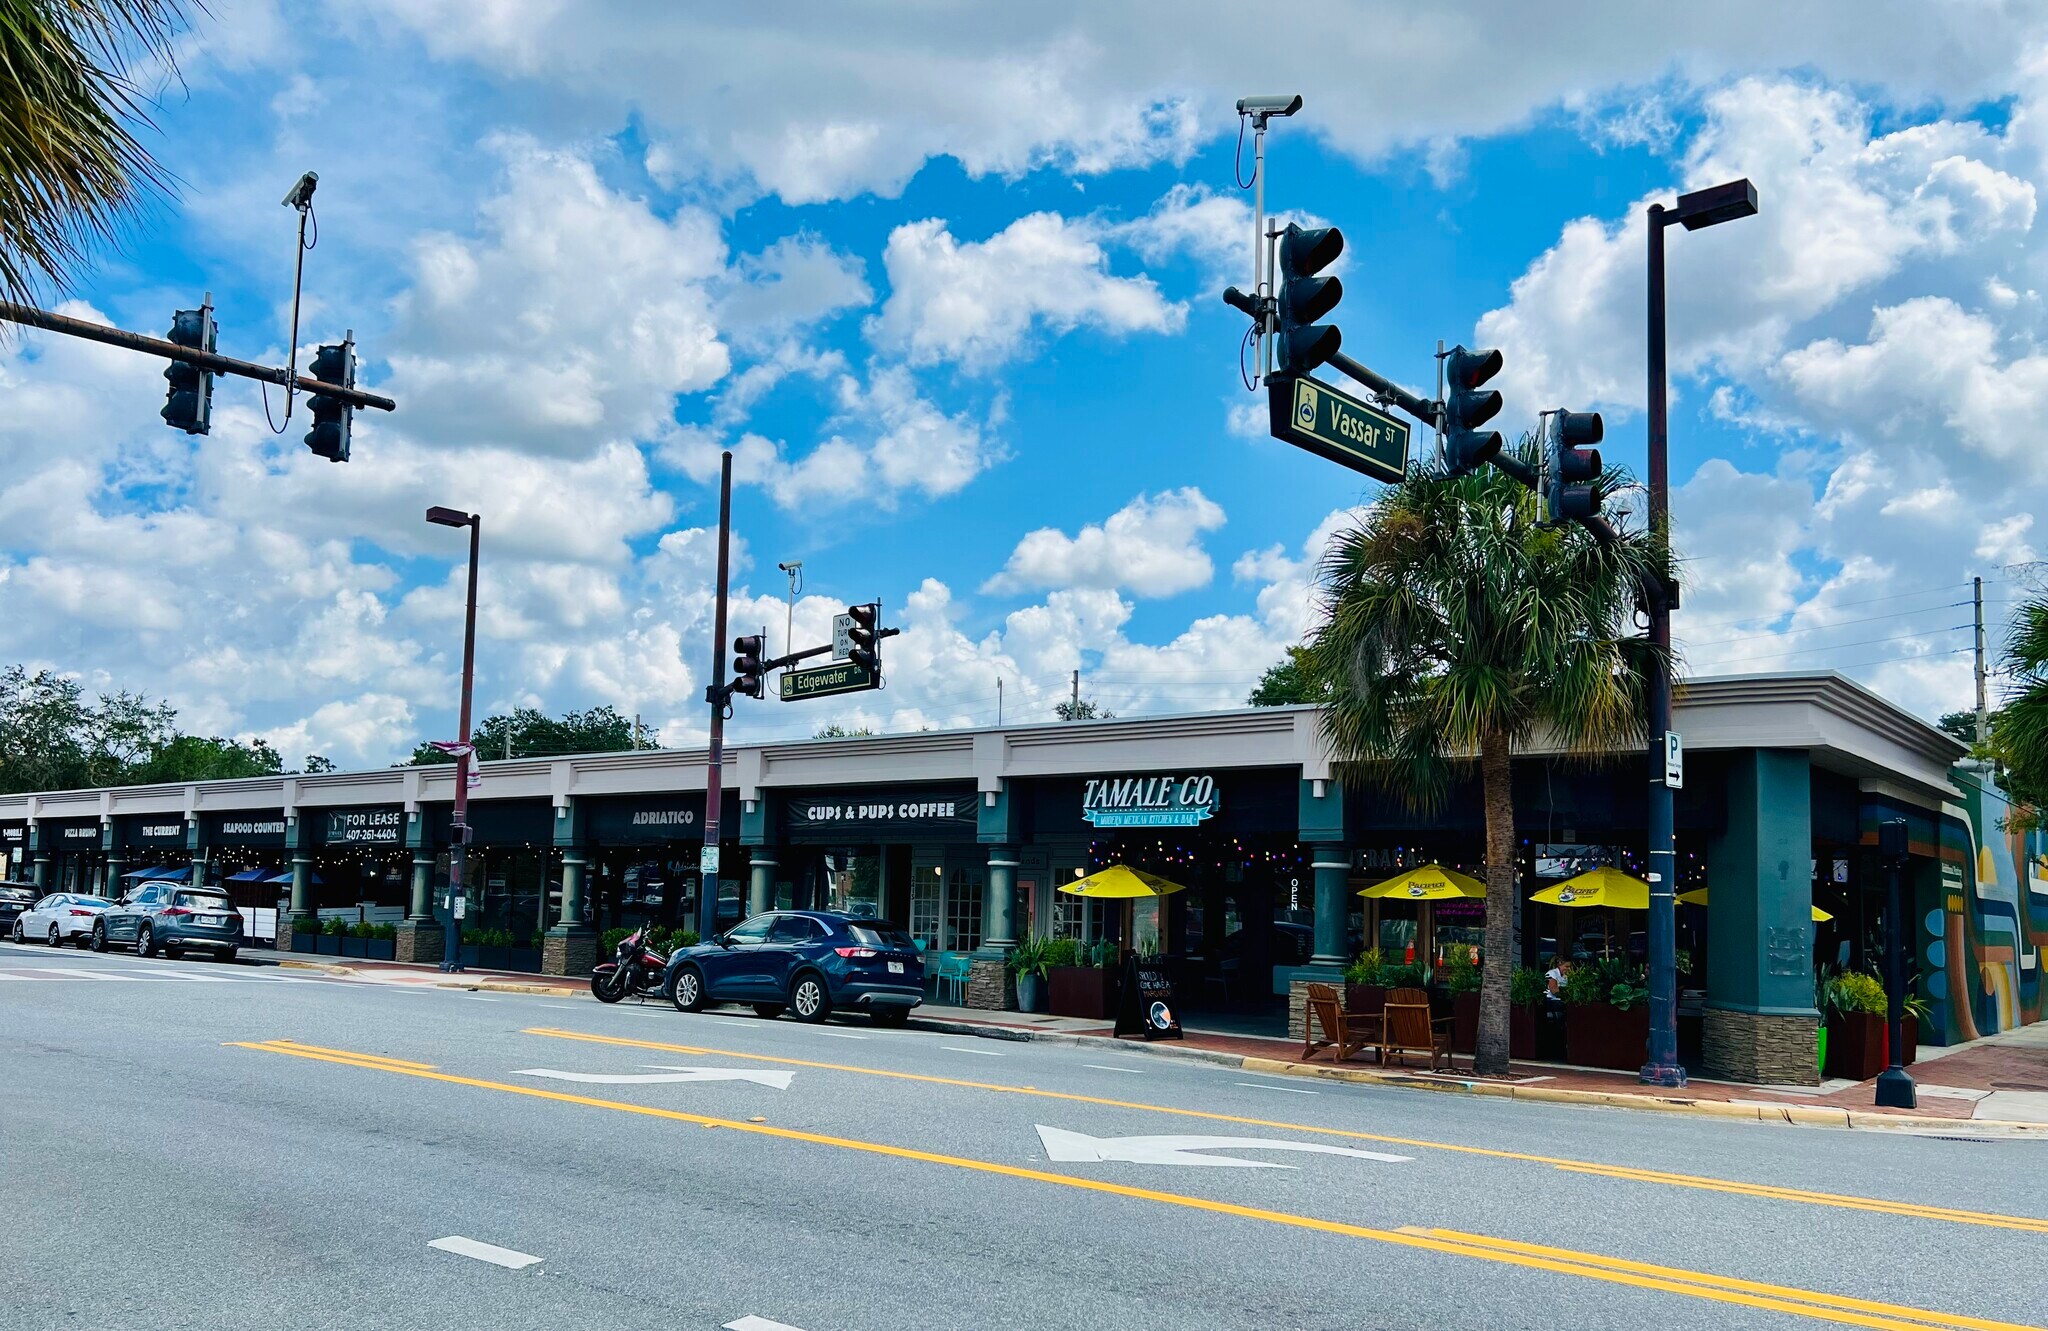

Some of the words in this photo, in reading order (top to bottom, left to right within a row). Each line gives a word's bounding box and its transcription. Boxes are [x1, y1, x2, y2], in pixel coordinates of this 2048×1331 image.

[1330, 400, 1381, 449] Vassar
[1385, 426, 1396, 443] ST
[839, 617, 851, 627] NO
[837, 629, 849, 637] TUR
[839, 638, 849, 646] ON
[838, 648, 849, 657] RED
[797, 670, 847, 692] Edgewater
[1670, 735, 1678, 759] P
[1082, 776, 1174, 808] TAMALE
[1179, 775, 1214, 805] CO.
[632, 810, 694, 825] ADRIATICO
[807, 805, 841, 820] CUPS
[845, 805, 855, 819] &
[858, 804, 894, 819] PUPS
[898, 802, 955, 818] COFFEE
[346, 814, 366, 826] FOR
[368, 812, 400, 826] LEASE
[1100, 814, 1122, 826] MODERN
[1123, 814, 1147, 825] MEXICAN
[1149, 813, 1173, 825] KITCHEN
[1174, 813, 1179, 825] &
[1180, 813, 1194, 826] BAR
[64, 828, 78, 838] PIZZA
[78, 827, 96, 837] BRUNO
[142, 826, 153, 836] THE
[153, 825, 181, 836] CURRENT
[222, 822, 252, 834] SEAFOOD
[253, 821, 285, 833] COUNTER
[345, 828, 397, 841] 407-261-4404
[1290, 878, 1298, 911] OPEN
